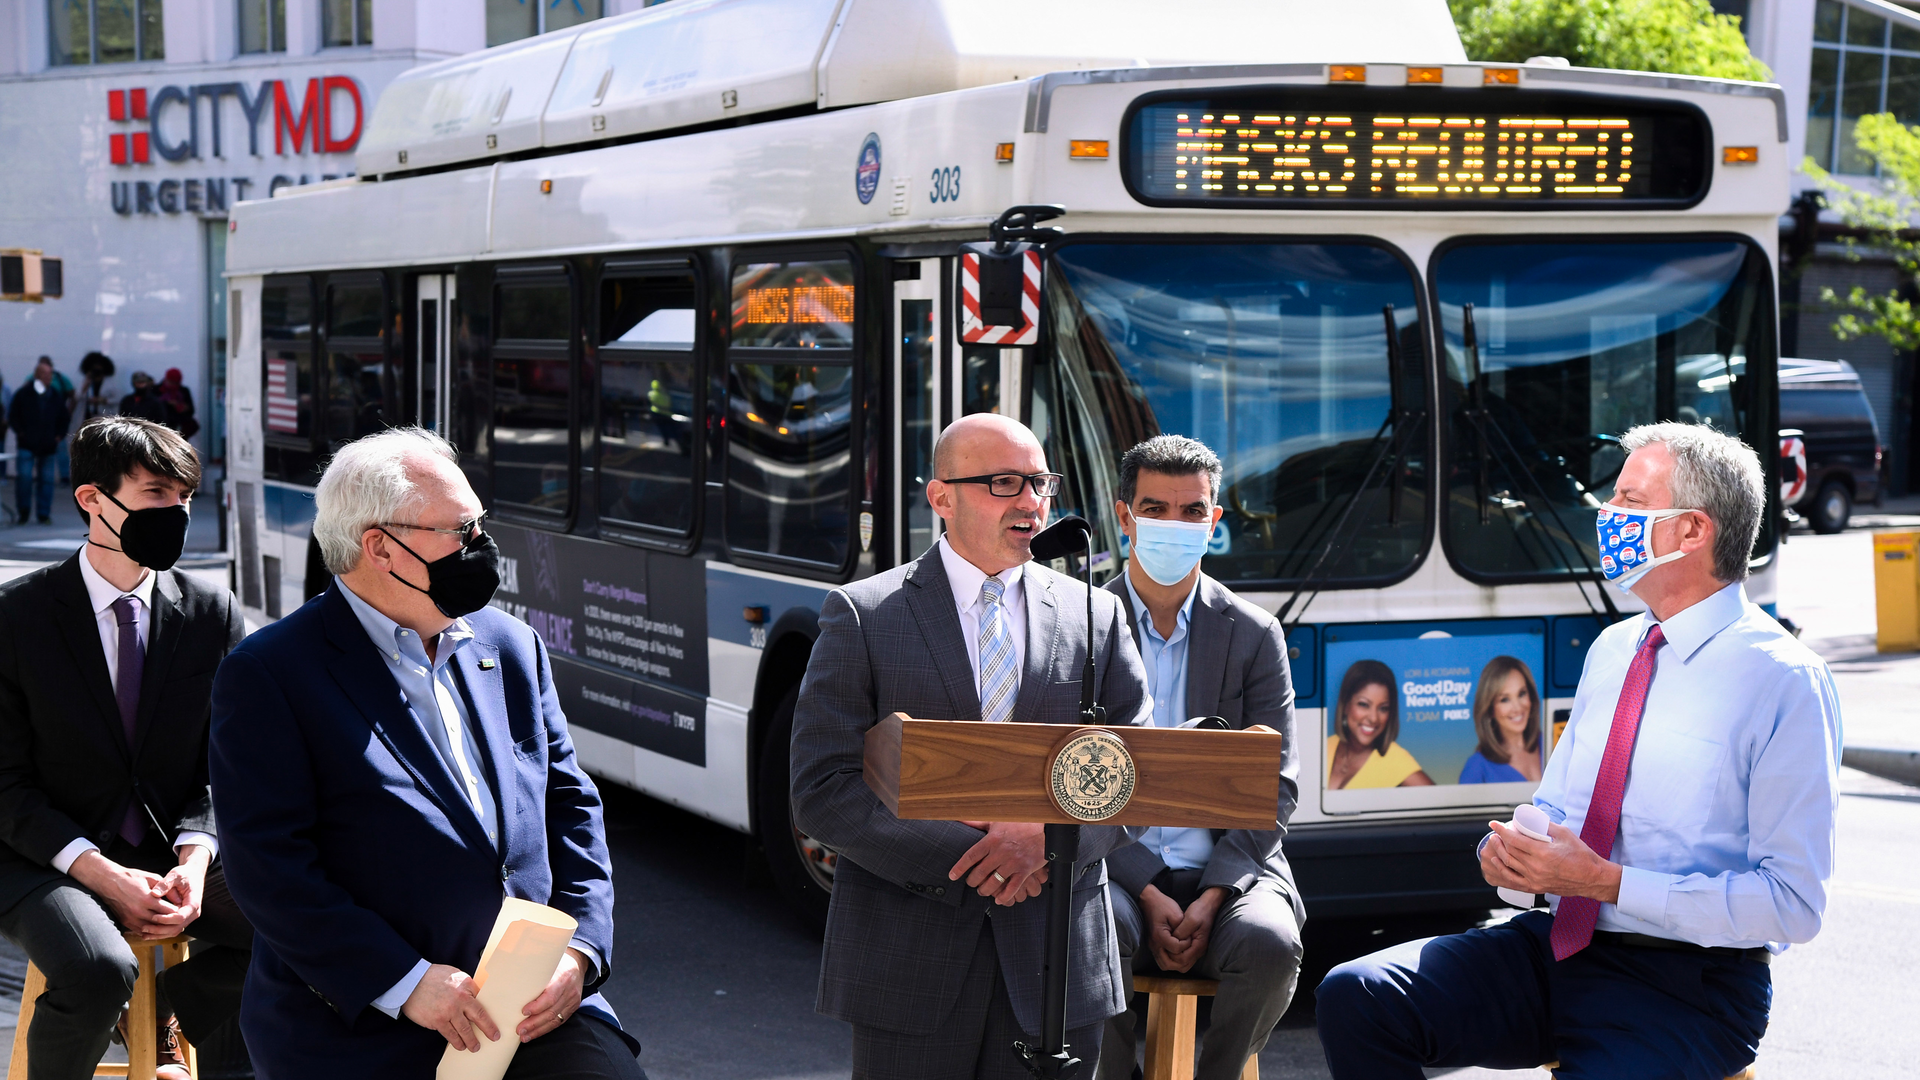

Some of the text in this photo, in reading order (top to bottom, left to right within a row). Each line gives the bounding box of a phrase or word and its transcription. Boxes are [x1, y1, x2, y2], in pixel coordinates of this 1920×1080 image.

[152, 75, 364, 162] CITYMD
[1176, 113, 1634, 193] MASKS REQUIRED
[111, 177, 252, 216] URGENT
[930, 165, 960, 203] 303
[747, 287, 789, 324] MASKS
[750, 627, 766, 648] 303
[1403, 680, 1472, 696] Good Day
[1406, 693, 1467, 707] New York
[1443, 709, 1470, 721] FOX5
